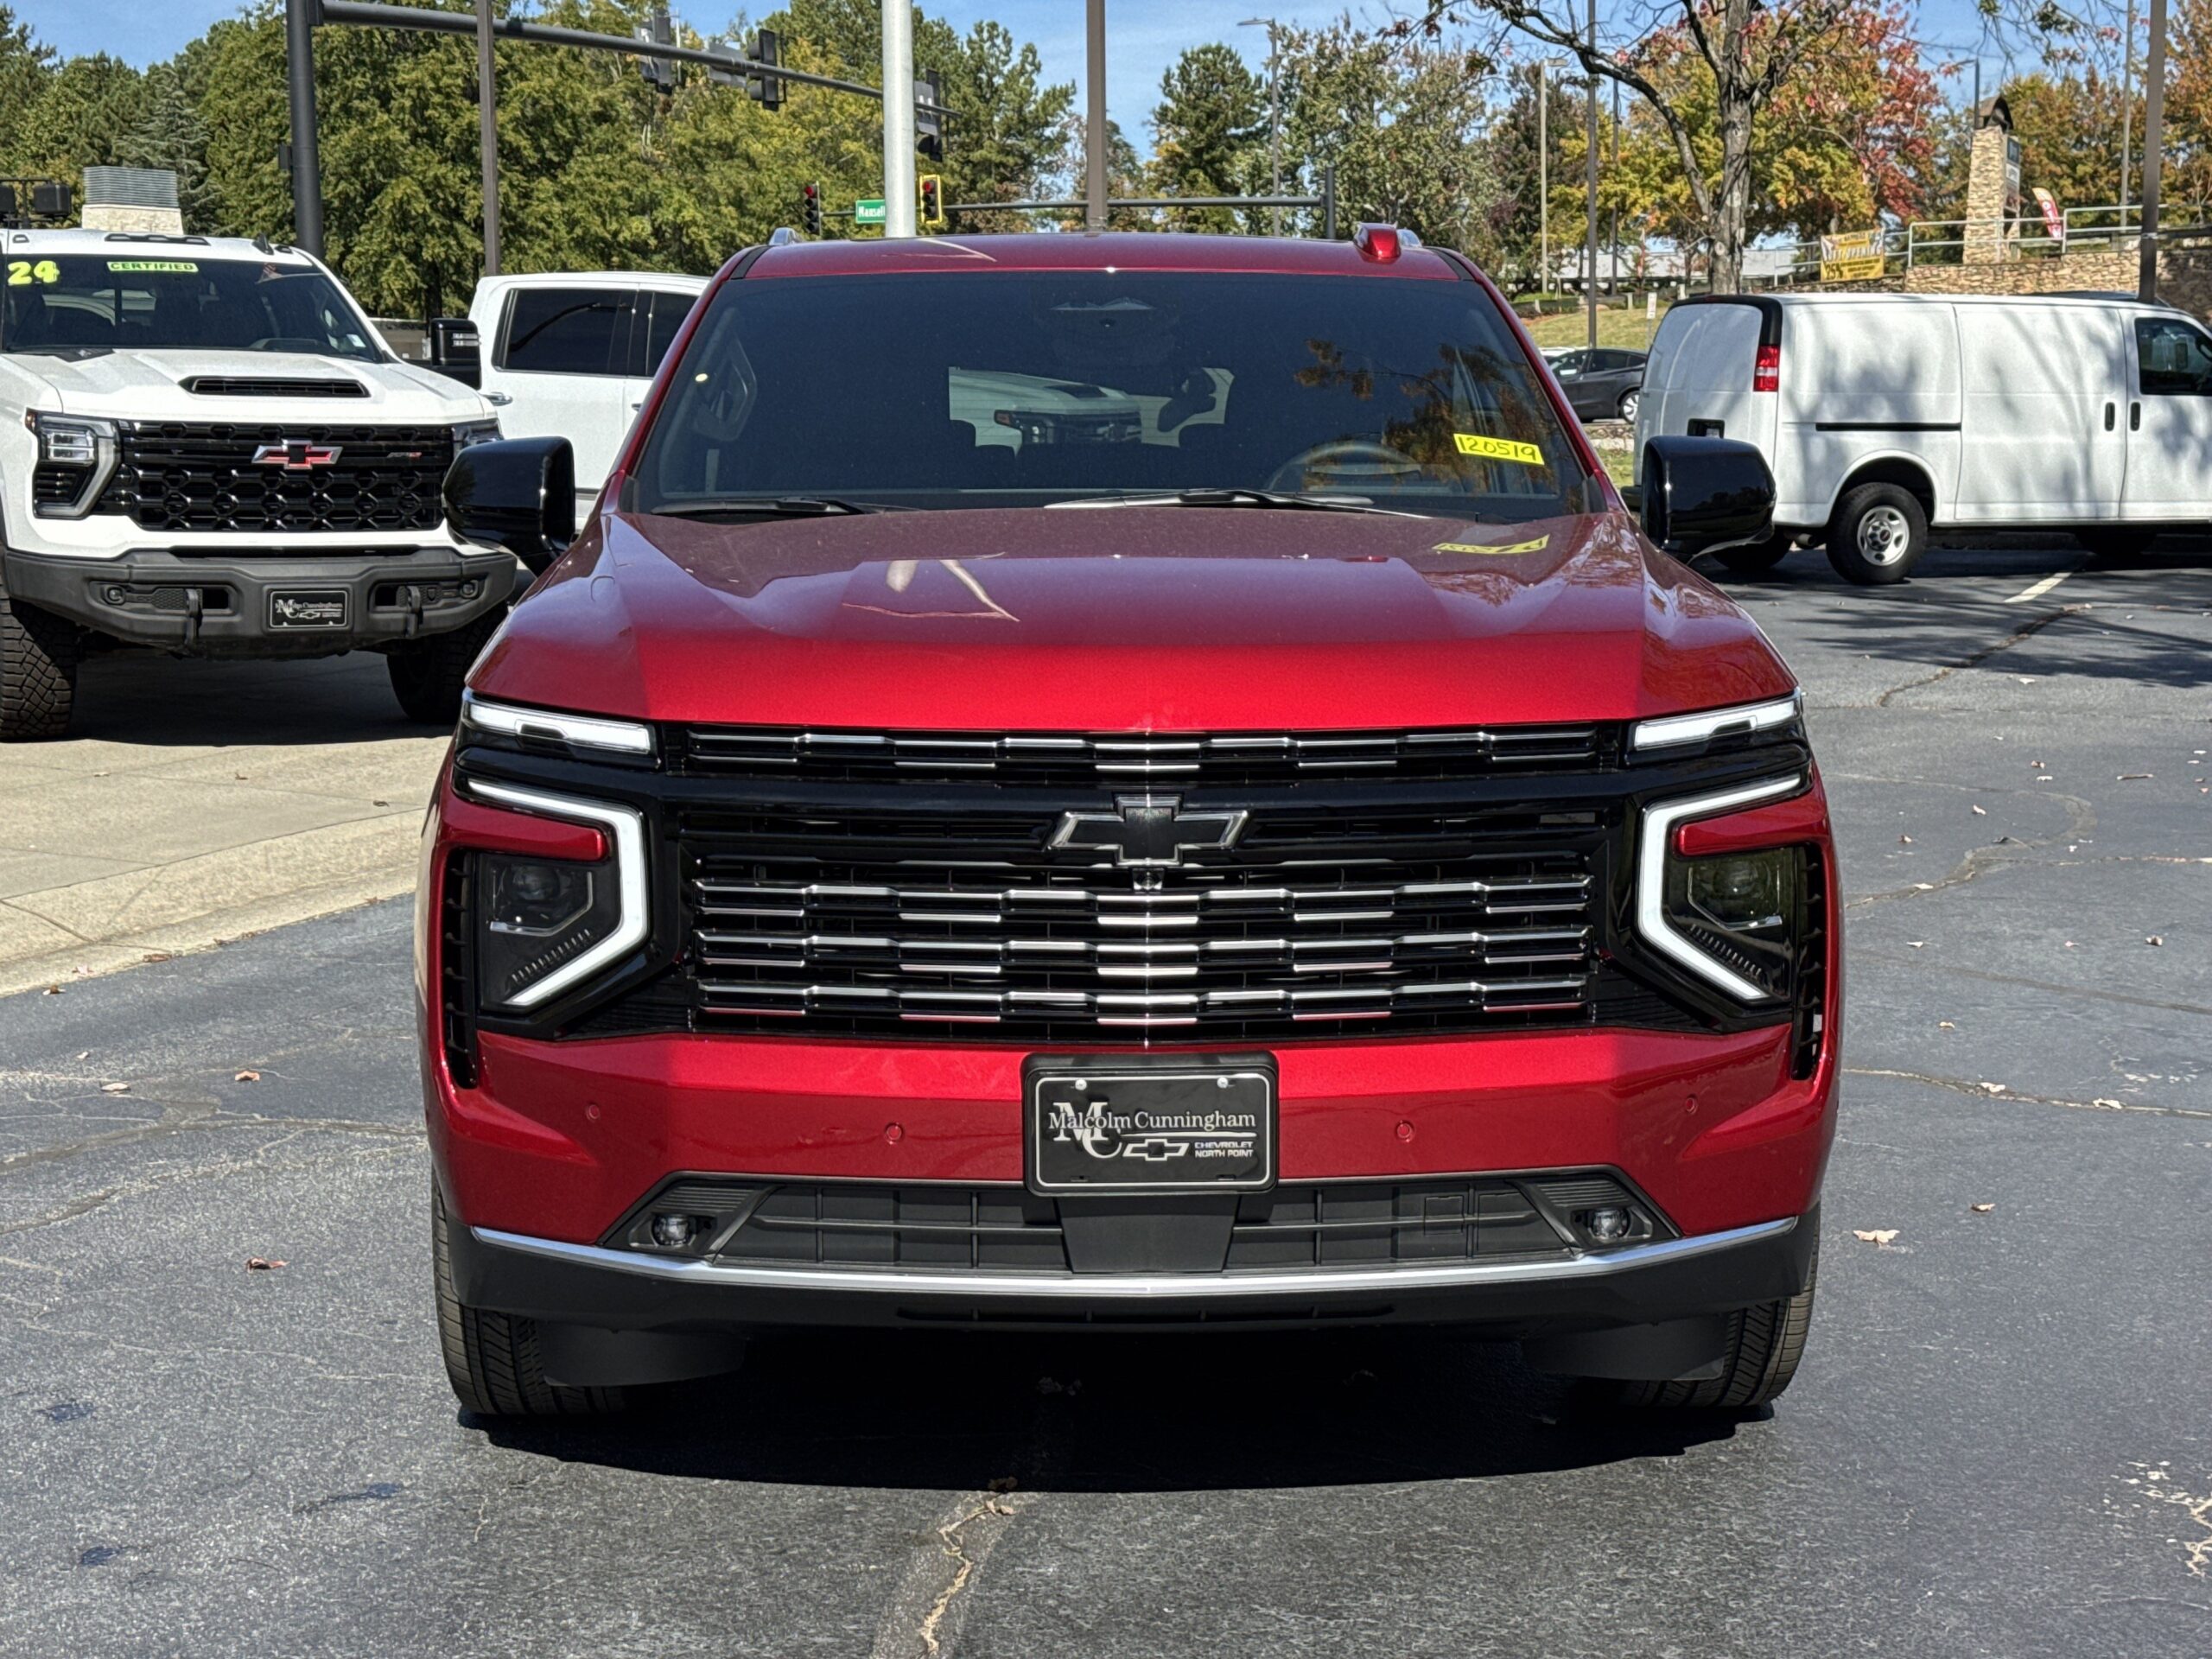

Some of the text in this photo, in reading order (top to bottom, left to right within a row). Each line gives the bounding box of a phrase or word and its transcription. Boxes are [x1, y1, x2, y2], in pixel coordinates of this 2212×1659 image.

[8, 260, 60, 285] 24
[111, 262, 194, 271] CERTIFIED
[1458, 436, 1536, 461] 120519
[1048, 1110, 1255, 1131] Malcolm Cunningham
[1194, 1149, 1253, 1158] NORTH POINT
